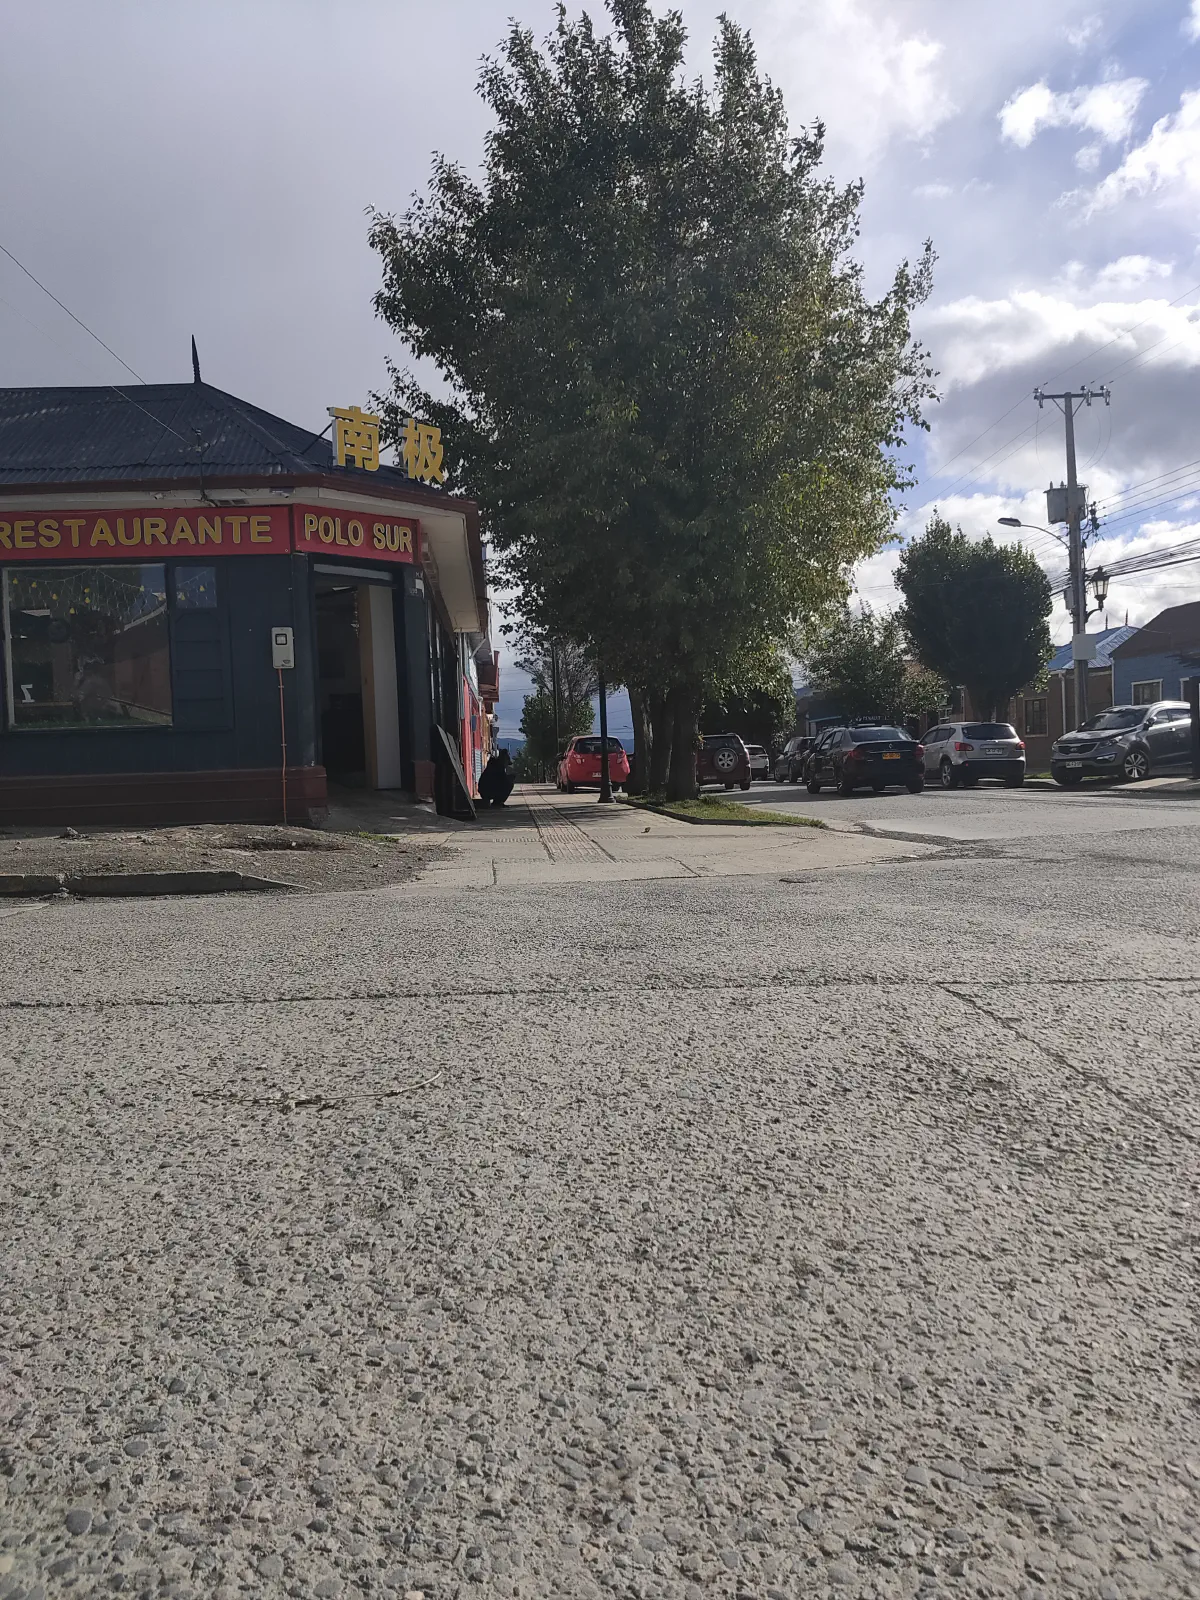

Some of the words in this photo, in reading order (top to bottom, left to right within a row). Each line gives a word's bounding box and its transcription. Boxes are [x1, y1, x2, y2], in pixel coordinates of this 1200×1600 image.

[328, 405, 444, 484] 南极
[304, 513, 364, 547] POLO
[373, 522, 413, 553] SUR
